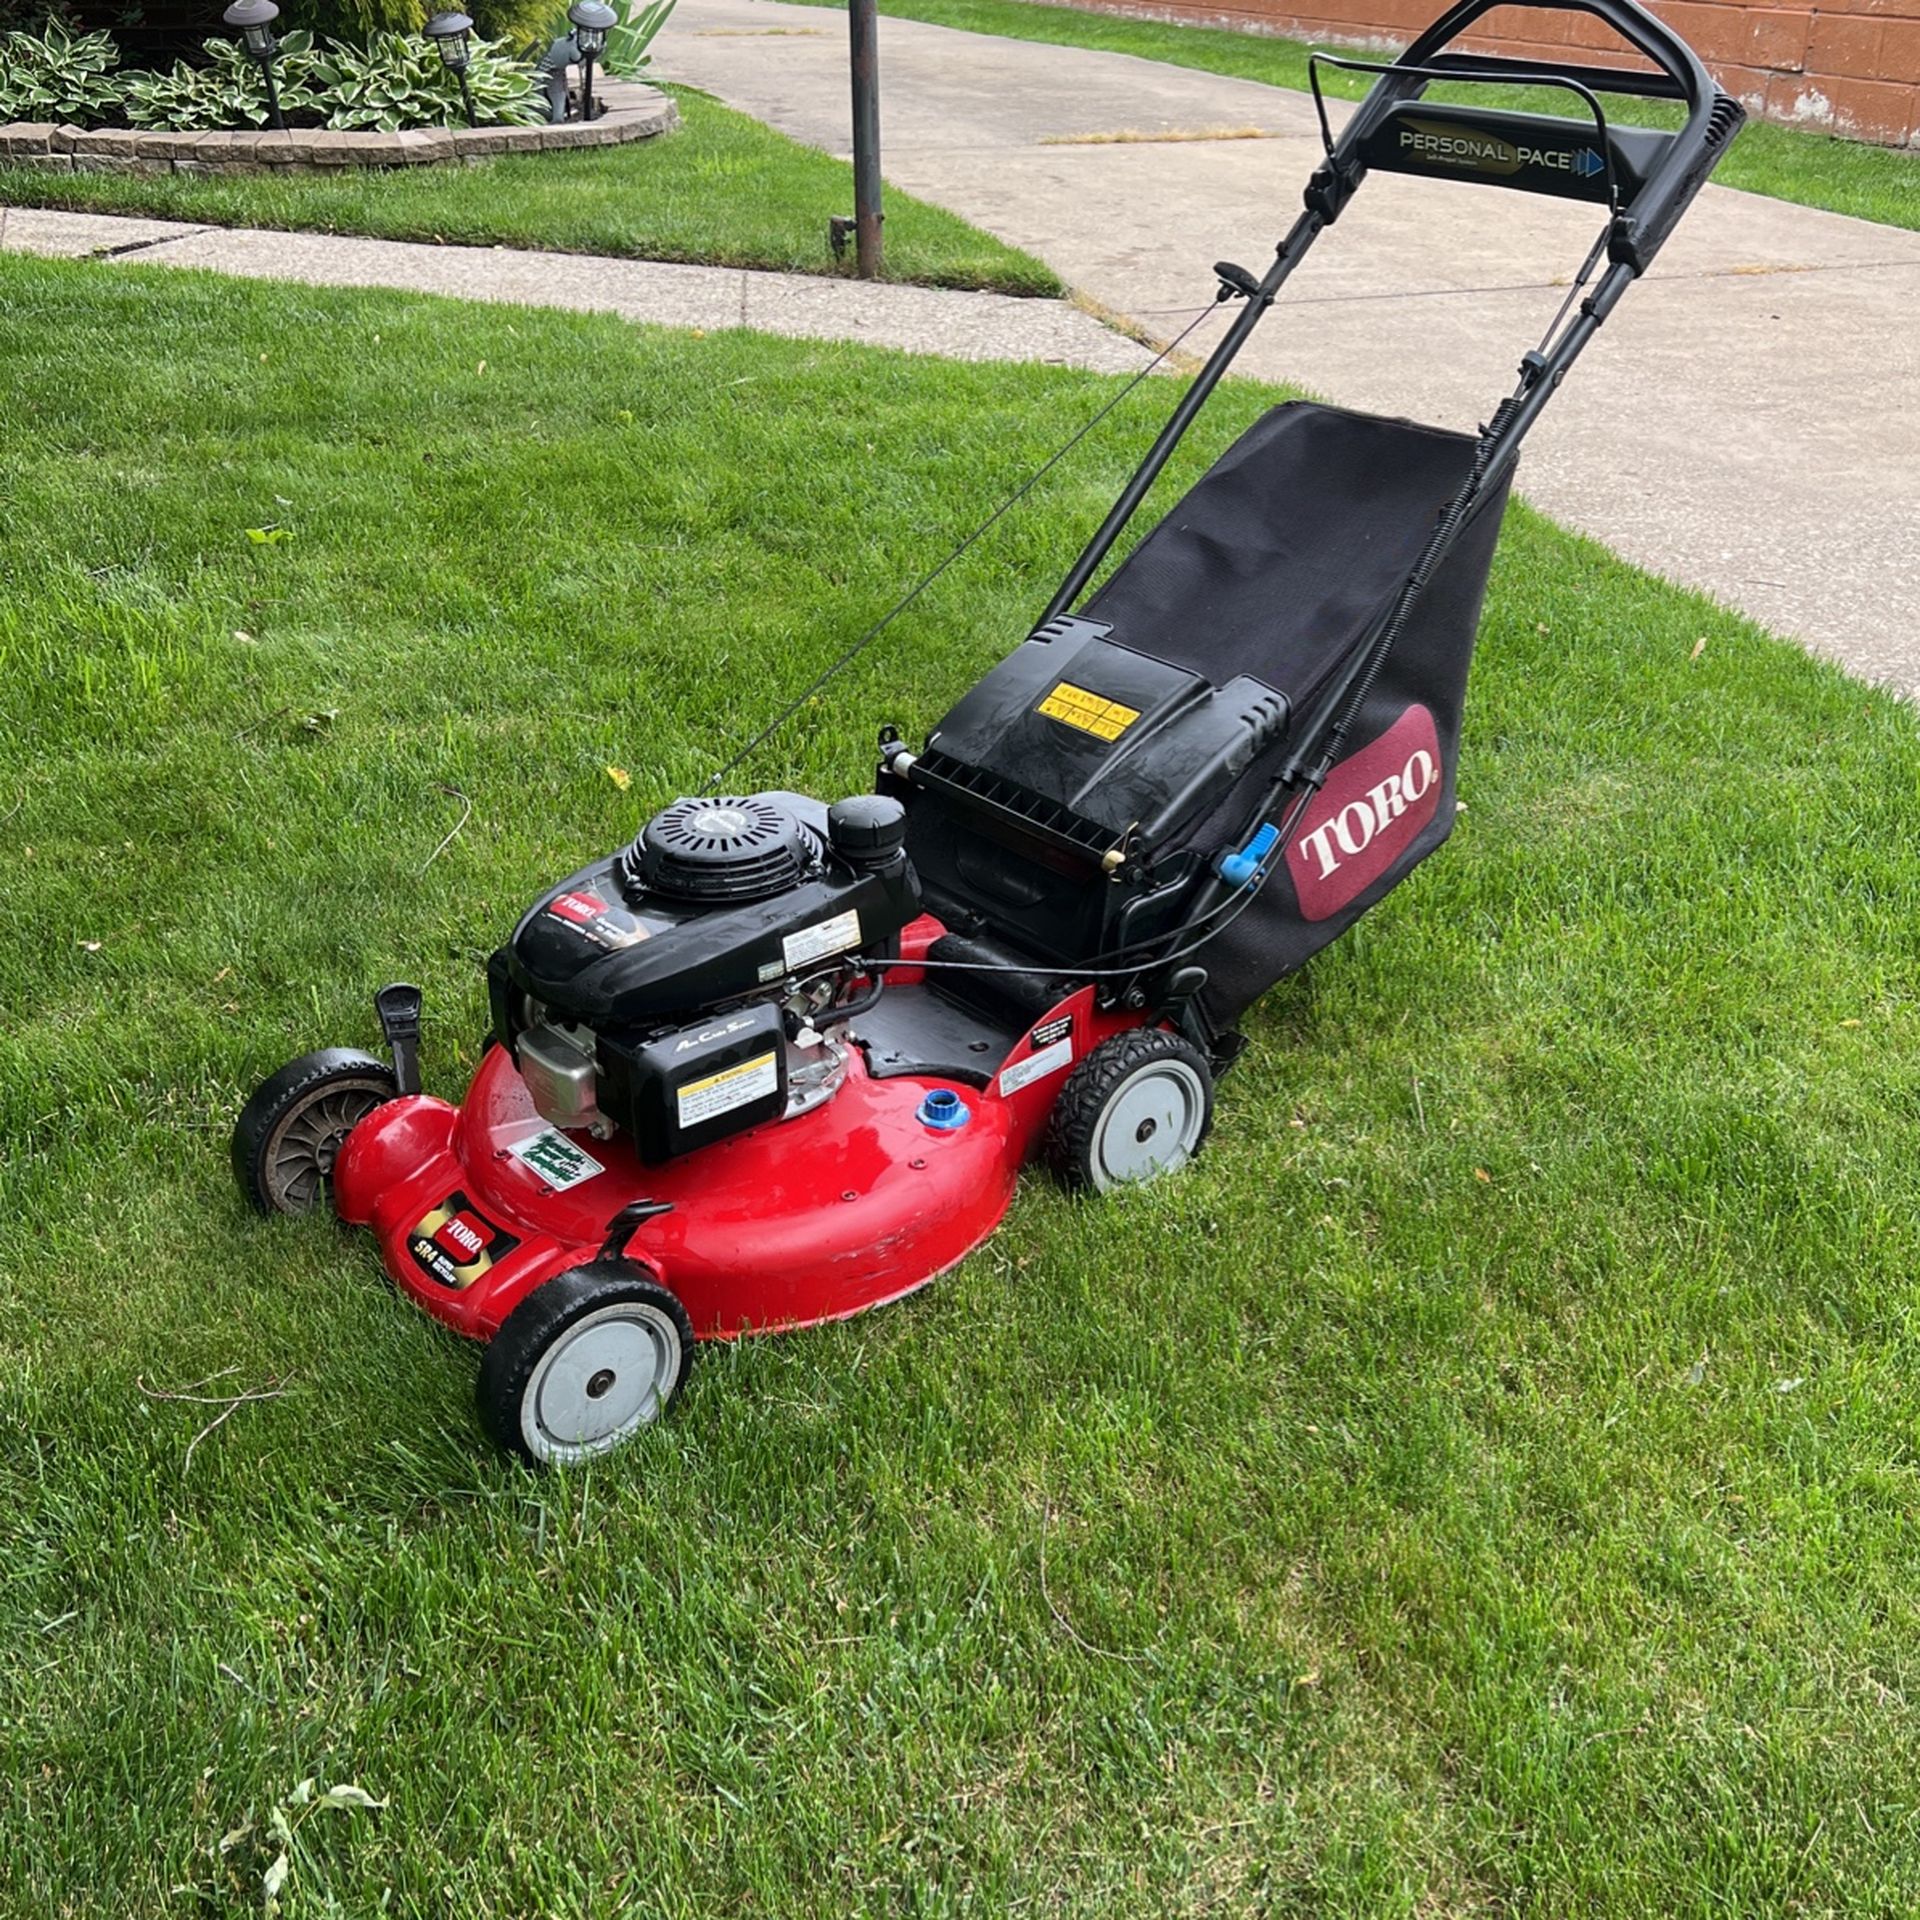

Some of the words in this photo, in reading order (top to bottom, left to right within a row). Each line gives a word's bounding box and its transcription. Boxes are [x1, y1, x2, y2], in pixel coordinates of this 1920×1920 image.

[1400, 131, 1509, 161] PERSONAL
[1517, 147, 1573, 170] PACE
[1299, 749, 1435, 881] TORO
[562, 896, 597, 917] TORO
[414, 1240, 438, 1263] SR4
[446, 1218, 483, 1253] TORO
